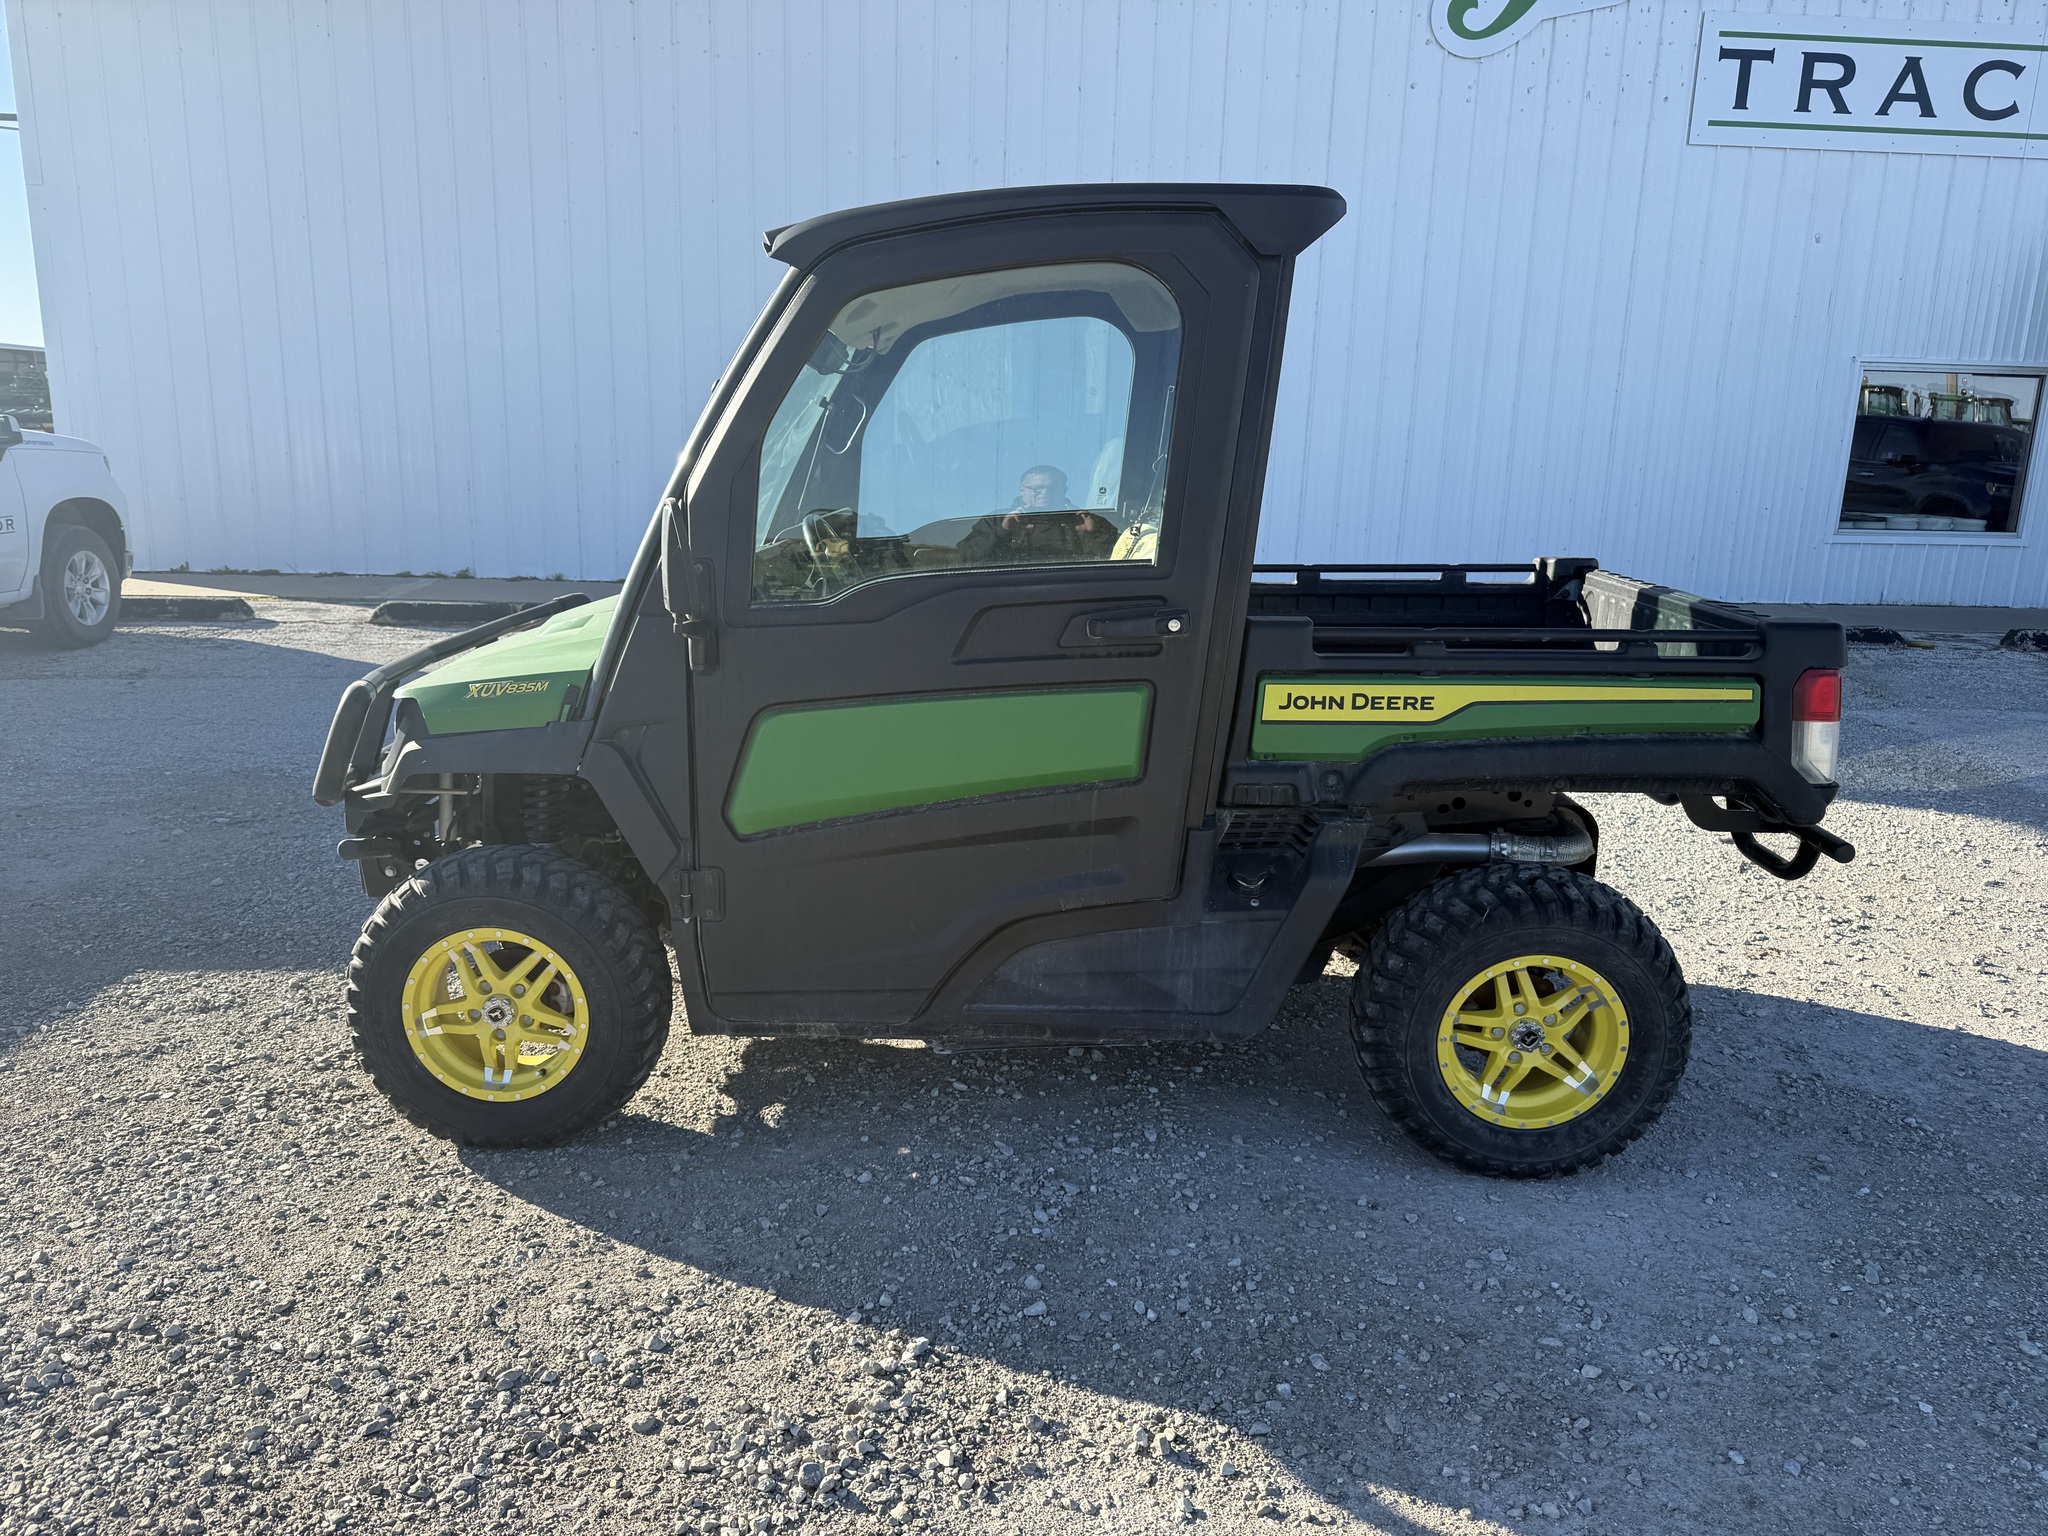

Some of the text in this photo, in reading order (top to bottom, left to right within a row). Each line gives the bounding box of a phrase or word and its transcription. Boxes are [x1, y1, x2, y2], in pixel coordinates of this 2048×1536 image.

[1718, 45, 2027, 121] TRAC
[465, 681, 550, 699] XUV835M
[1278, 692, 1435, 710] JOHN DEERE
